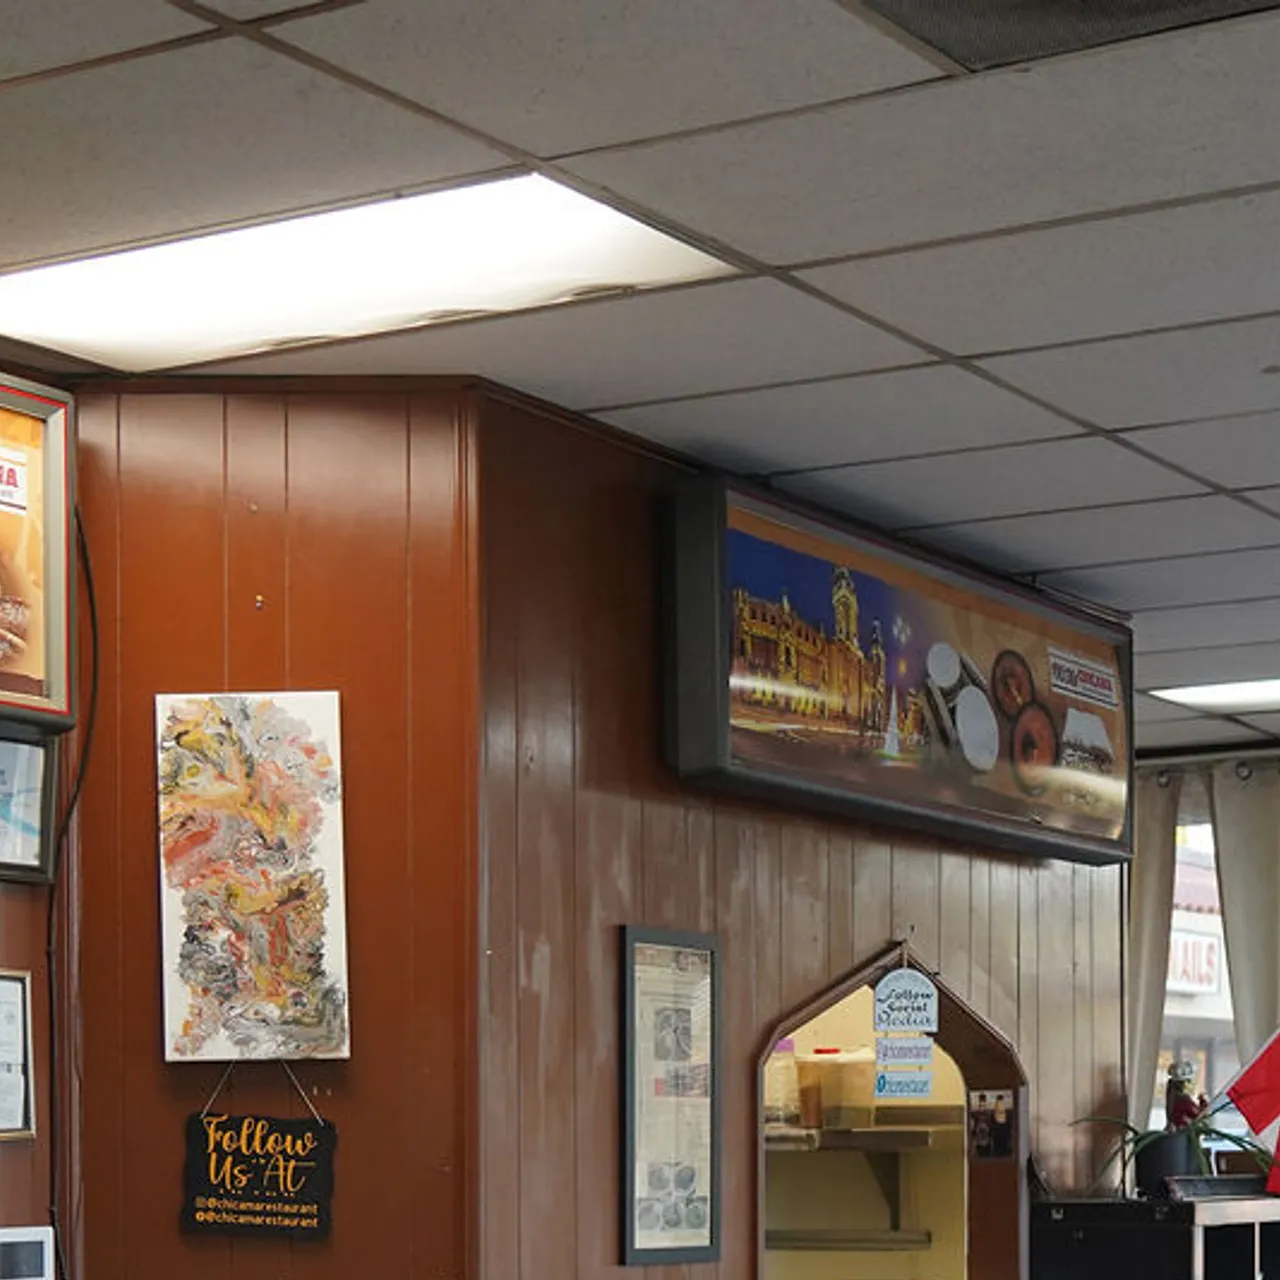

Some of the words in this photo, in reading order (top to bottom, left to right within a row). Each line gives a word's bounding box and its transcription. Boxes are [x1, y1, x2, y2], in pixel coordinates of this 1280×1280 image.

[203, 1113, 319, 1156] Follow
[208, 1152, 254, 1192] Us
[263, 1154, 317, 1193] At
